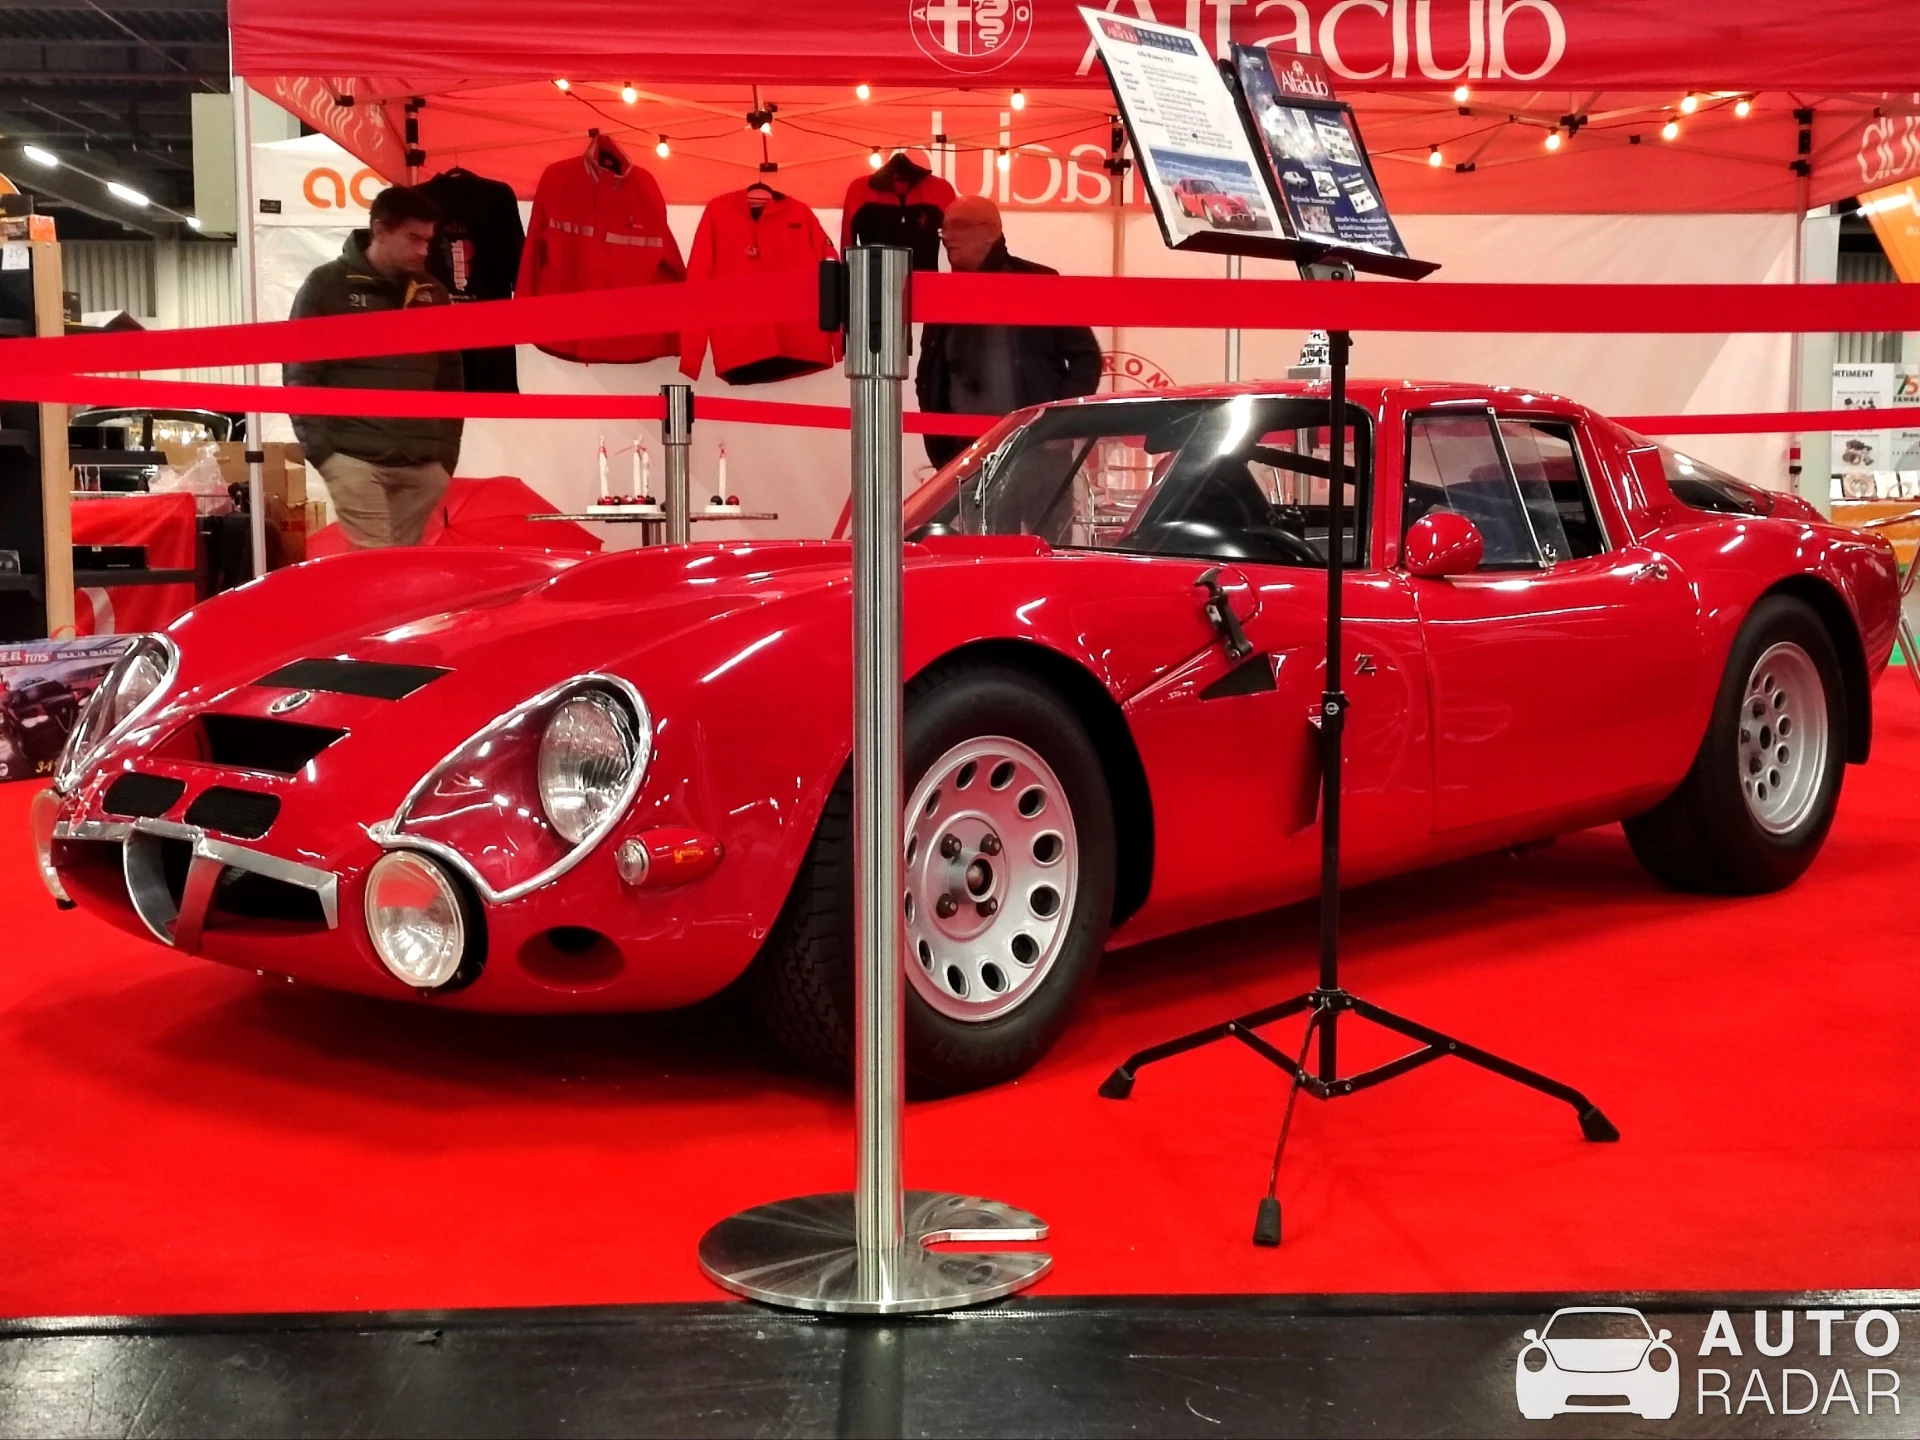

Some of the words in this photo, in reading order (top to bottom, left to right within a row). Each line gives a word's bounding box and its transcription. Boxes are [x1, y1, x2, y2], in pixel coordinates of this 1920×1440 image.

[1281, 70, 1328, 97] Alfaclub
[1895, 374, 1919, 396] 75
[24, 653, 49, 664] TOYS
